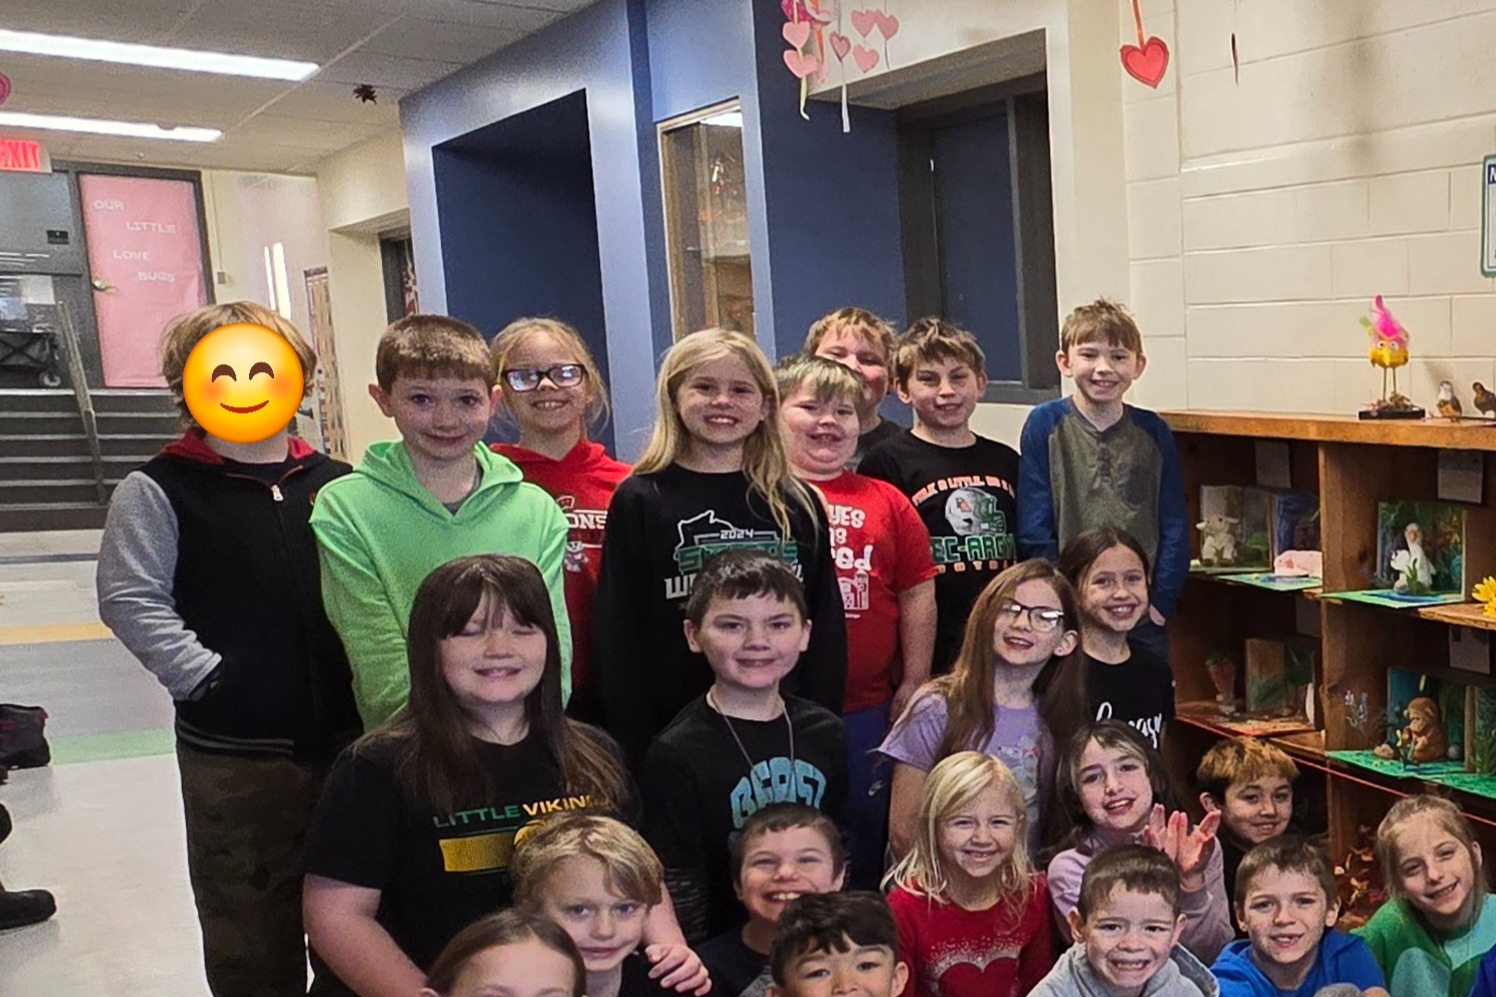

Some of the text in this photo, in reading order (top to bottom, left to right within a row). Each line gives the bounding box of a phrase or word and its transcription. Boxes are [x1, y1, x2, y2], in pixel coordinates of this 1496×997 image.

[93, 200, 124, 210] OUR
[126, 221, 176, 234] LITTLE
[113, 250, 150, 261] LOVE
[137, 271, 175, 283] BUGS
[719, 528, 754, 539] 2024
[433, 795, 592, 828] LITTLE VIKIN
